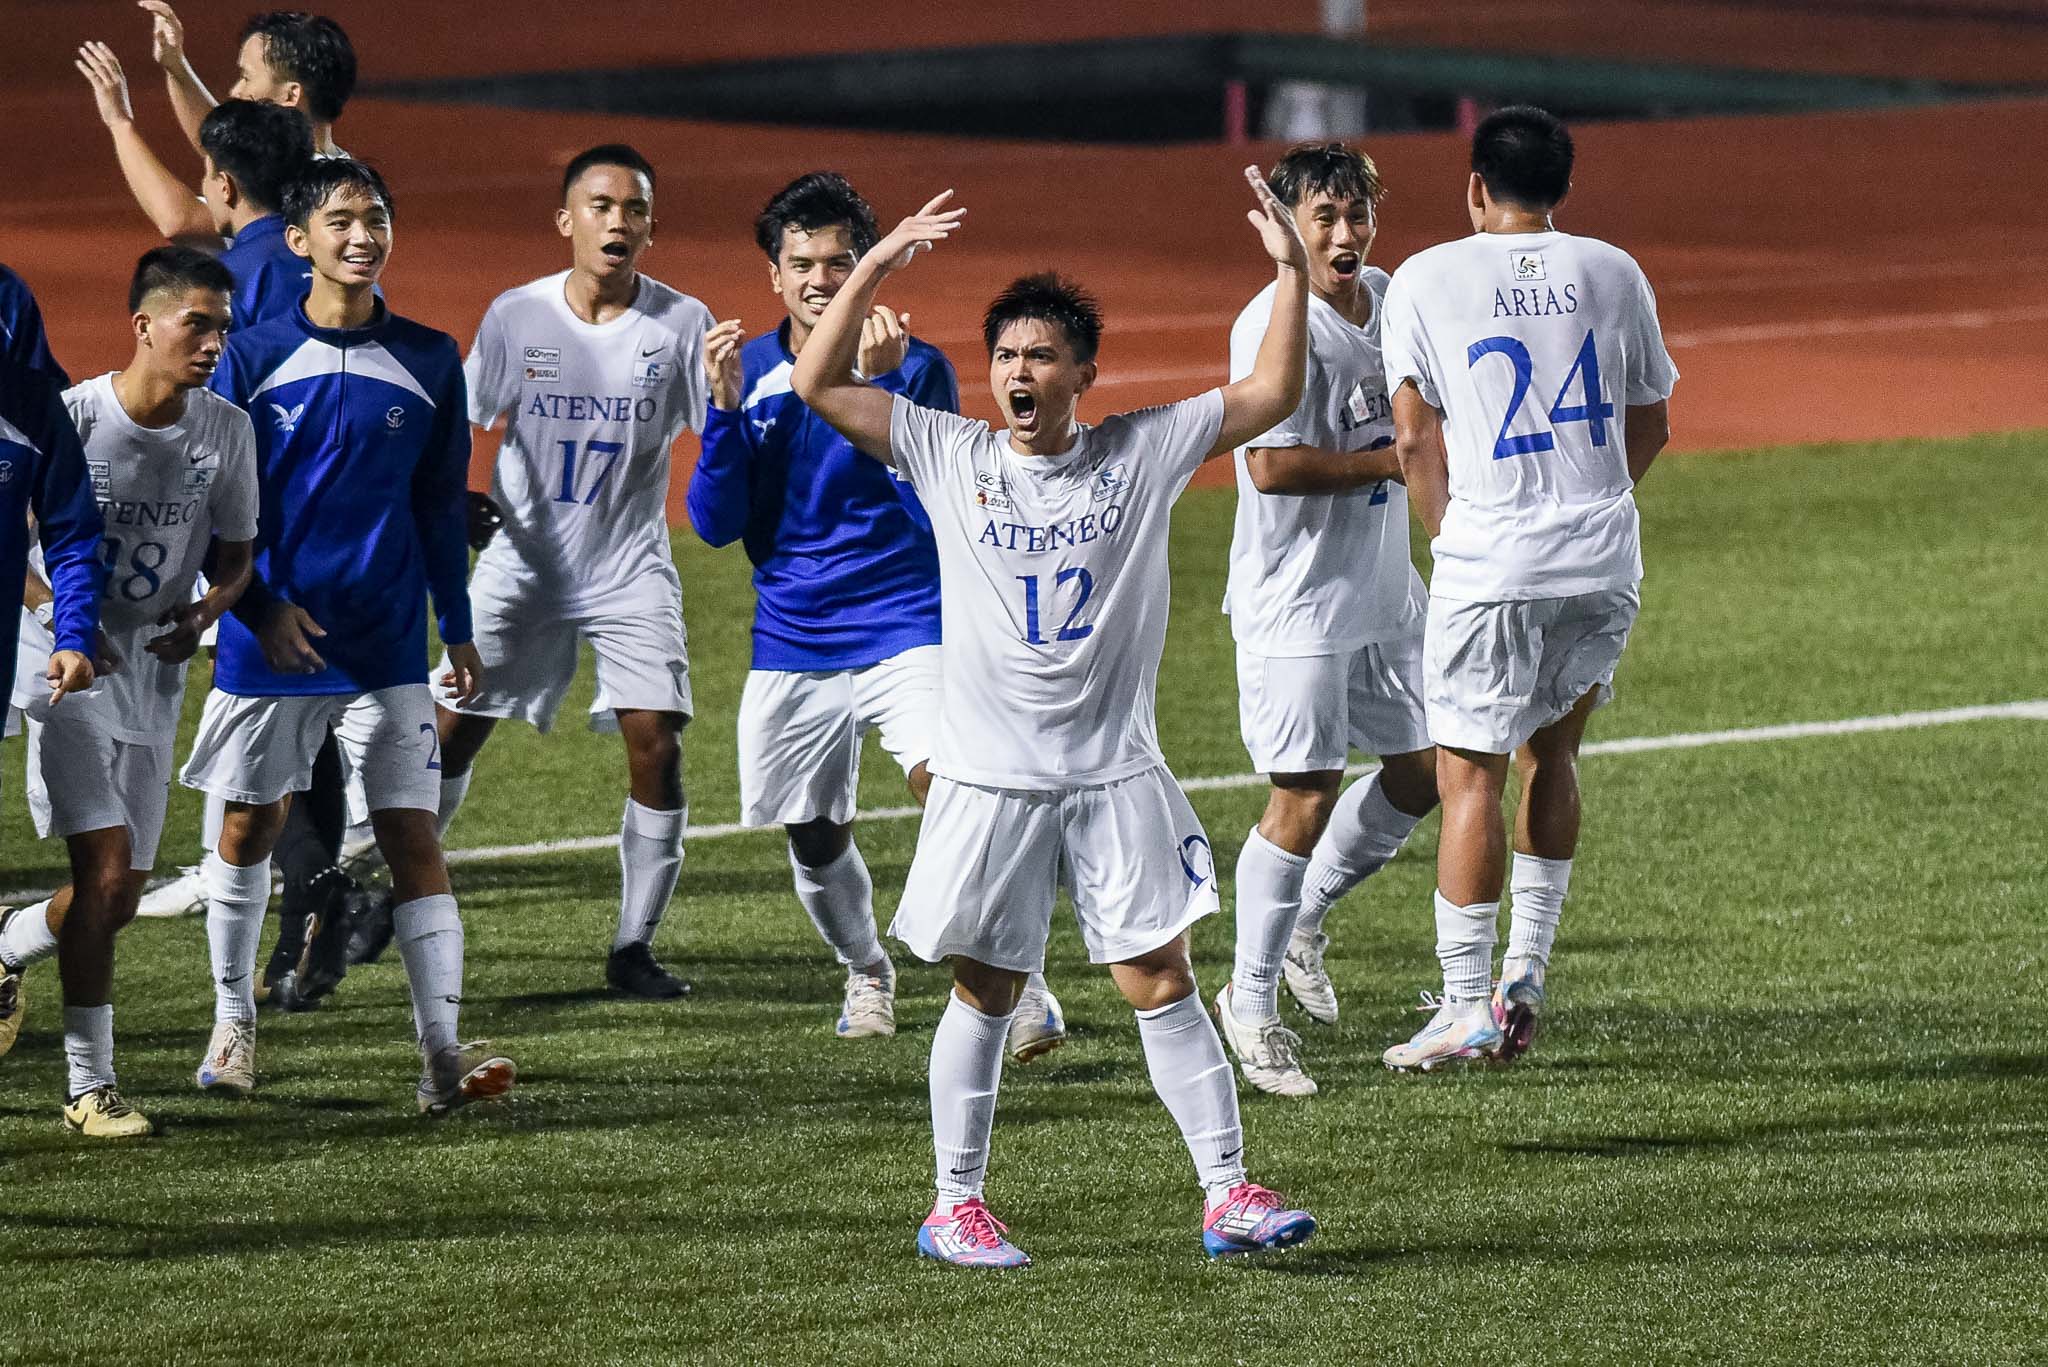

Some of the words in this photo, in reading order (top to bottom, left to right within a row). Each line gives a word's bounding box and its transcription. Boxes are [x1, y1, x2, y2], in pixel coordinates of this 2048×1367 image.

[1493, 284, 1578, 318] ARIAS
[528, 393, 657, 422] ATENEO
[1467, 328, 1614, 460] 24
[553, 440, 624, 505] 17
[100, 500, 199, 526] TENEO
[978, 505, 1121, 552] ATENEO
[102, 537, 168, 600] 18
[1015, 567, 1094, 645] 12
